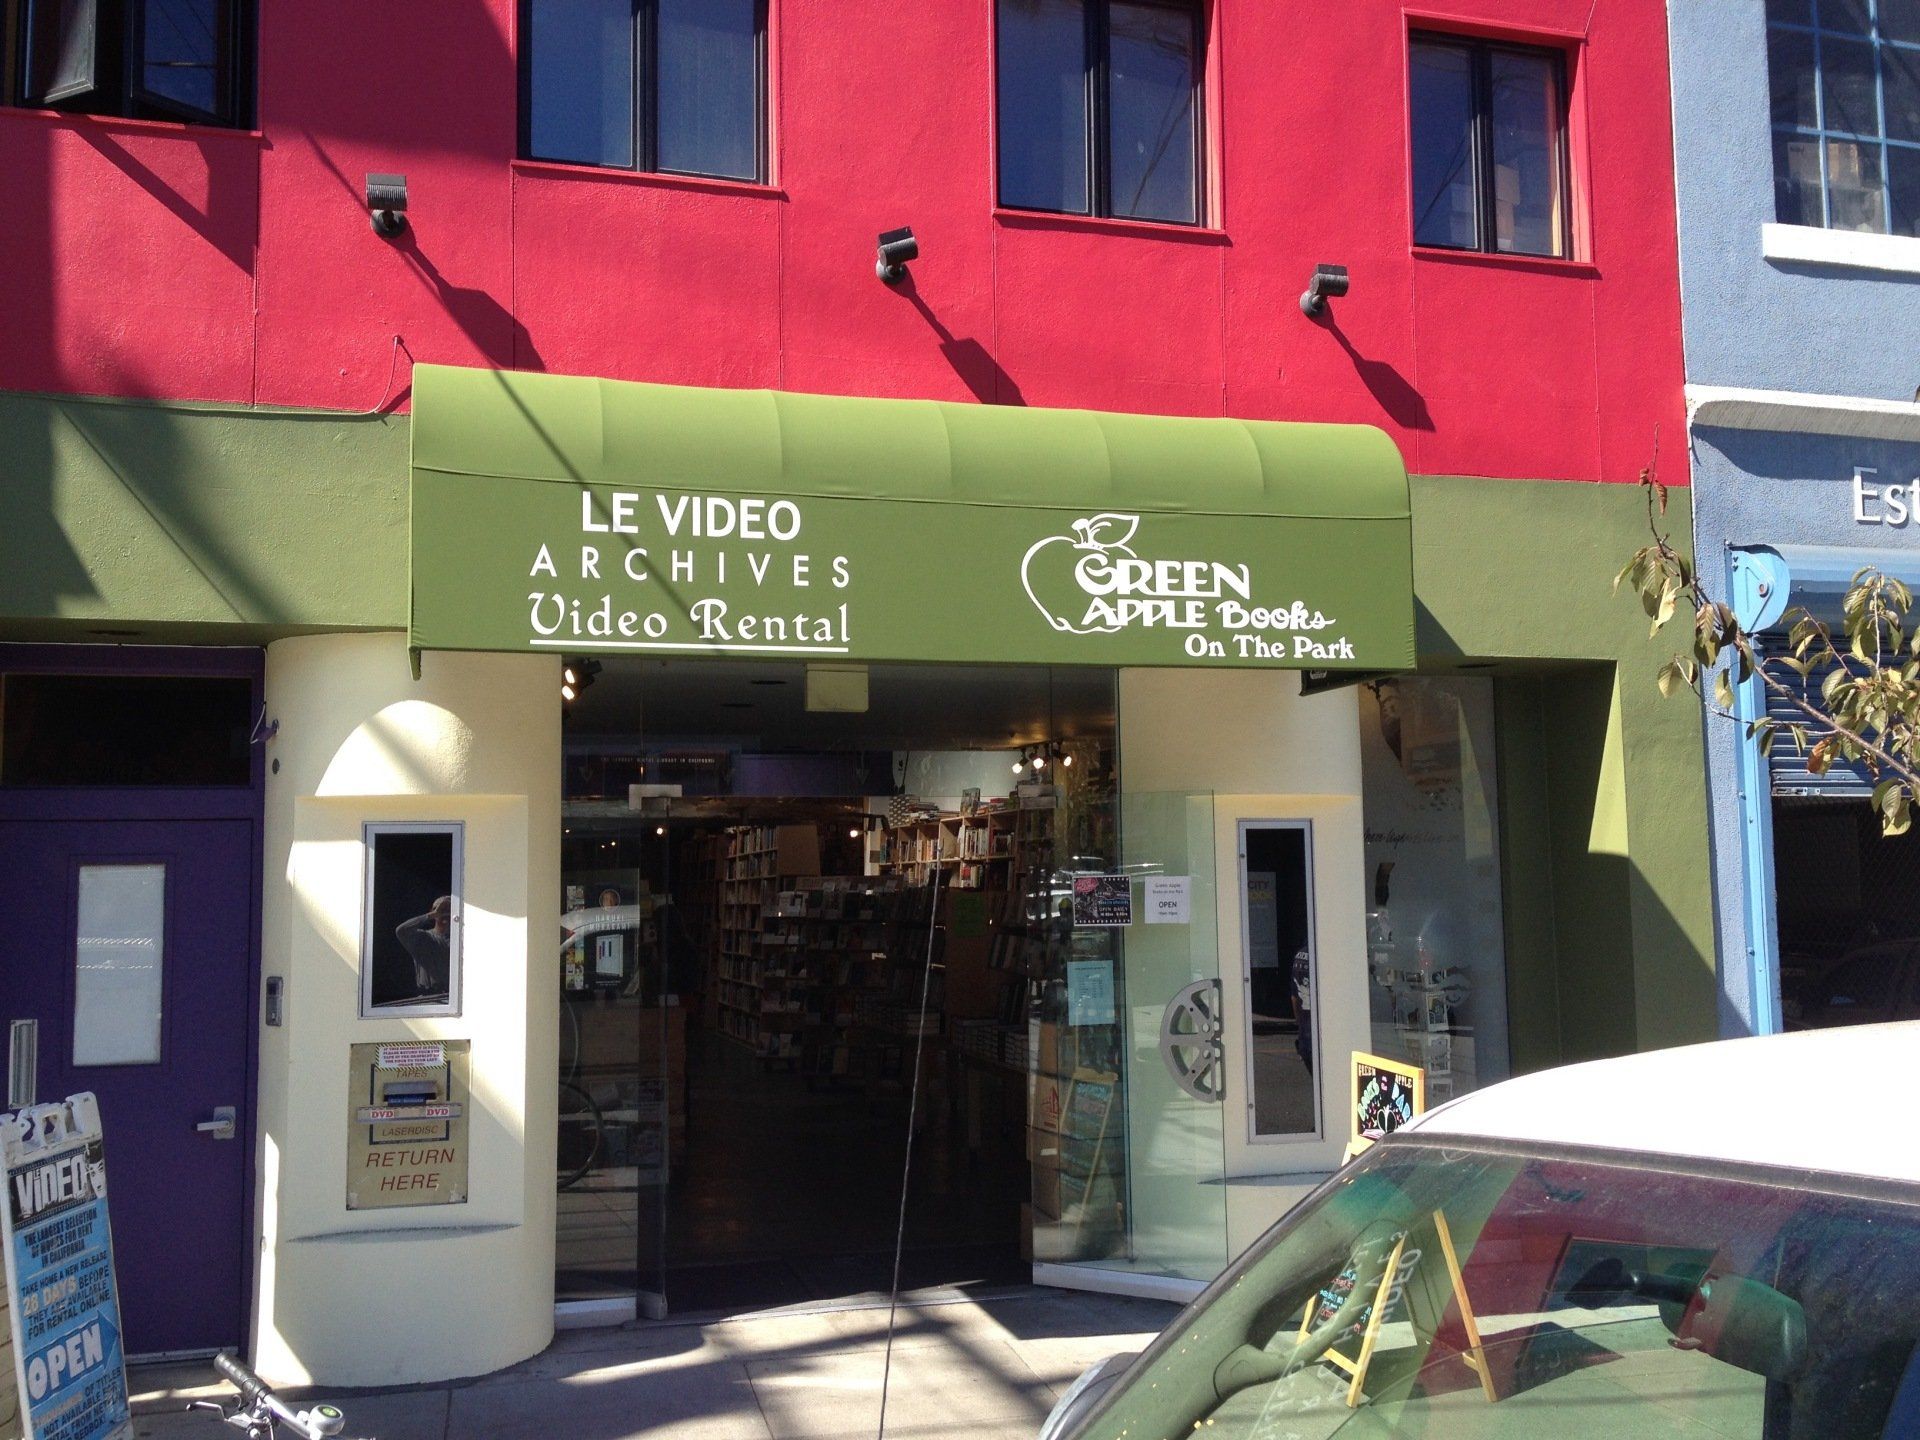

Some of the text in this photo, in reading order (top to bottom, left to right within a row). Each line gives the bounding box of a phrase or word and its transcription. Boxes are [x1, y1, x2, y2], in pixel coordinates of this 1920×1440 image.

[582, 490, 801, 541] LE VIDEO
[529, 543, 850, 588] ARCHIVES
[1074, 553, 1250, 600] GREEN
[527, 592, 851, 642] Video Rental
[1081, 597, 1336, 630] APPLE Books
[1184, 633, 1356, 660] On The Park
[395, 1069, 429, 1078] TAPES
[371, 1108, 449, 1119] DVD DVD
[382, 1125, 439, 1137] LASERDISC
[366, 1148, 455, 1168] RETURN
[380, 1172, 440, 1191] HERE
[24, 1207, 97, 1248] THE LARGEST SELECTION
[65, 1228, 77, 1244] FOR
[77, 1221, 93, 1238] RENT
[49, 1238, 85, 1264] CALIFORNIA
[21, 1281, 39, 1297] TAKE
[40, 1272, 58, 1289] HOME
[65, 1263, 79, 1277] NEW
[80, 1250, 107, 1270] RELEASE
[79, 1265, 110, 1290] BEFORE
[28, 1308, 49, 1327] THEY
[67, 1280, 107, 1307] AVAILABLE
[28, 1289, 110, 1341] FOR RENTAL ONLINE
[27, 1322, 103, 1400] OPEN
[43, 1419, 59, 1439] NOT
